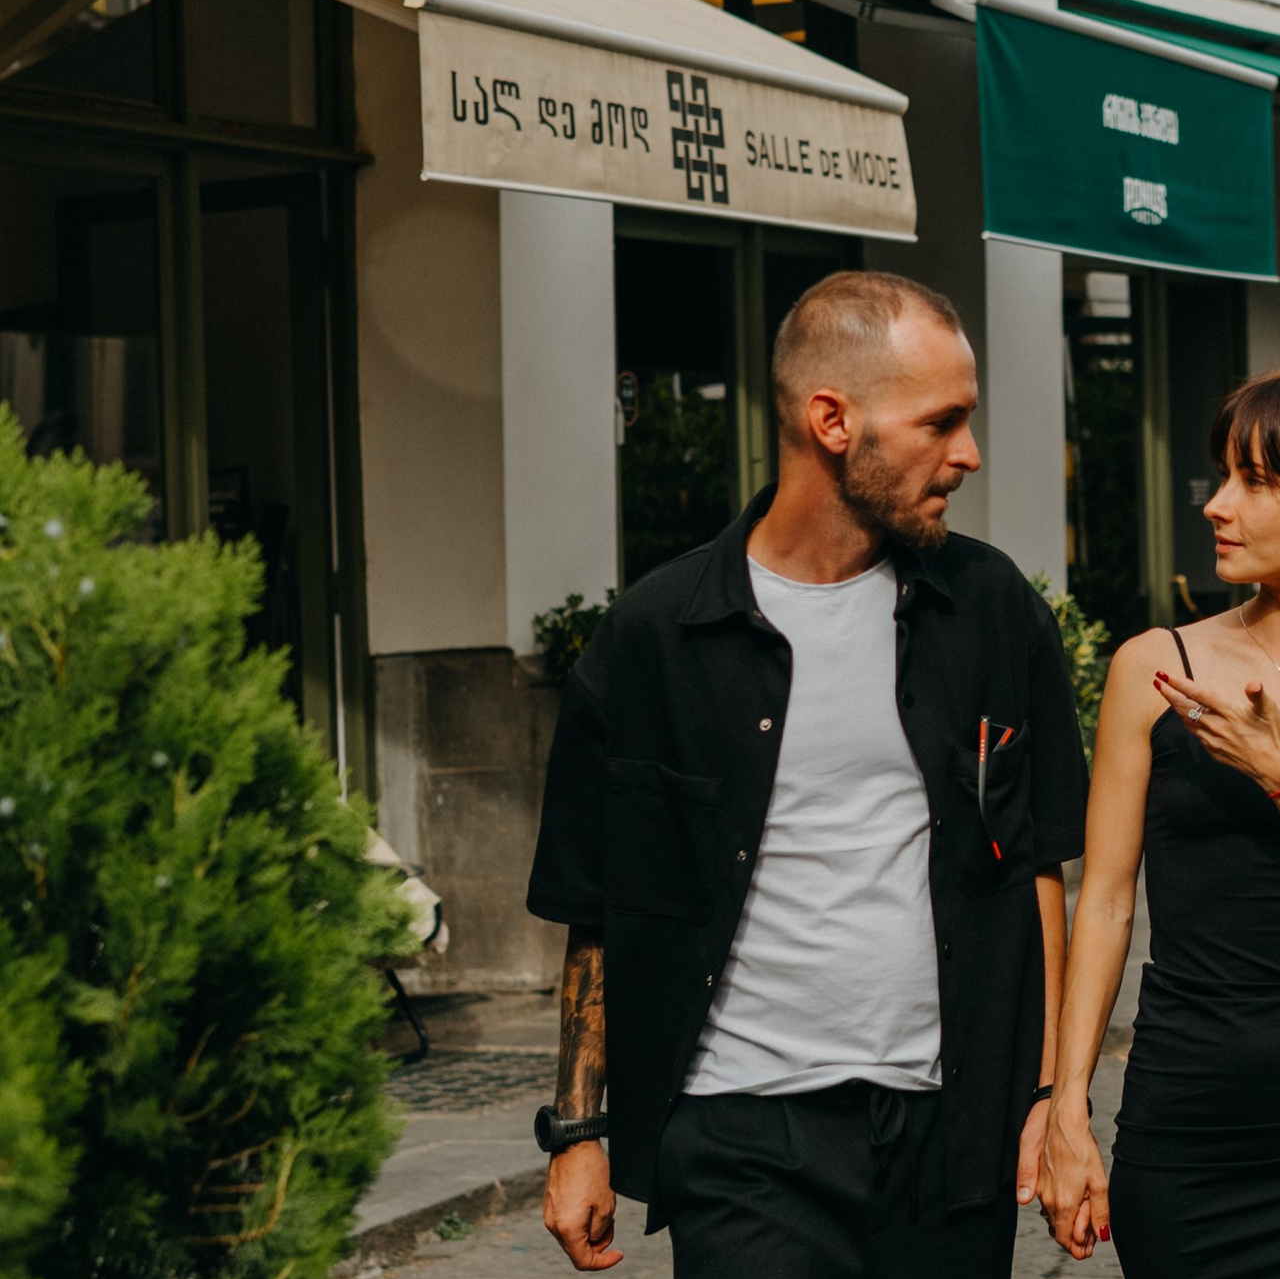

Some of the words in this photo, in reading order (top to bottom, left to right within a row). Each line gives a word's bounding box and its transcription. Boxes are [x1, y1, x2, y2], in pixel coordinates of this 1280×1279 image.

[451, 71, 522, 132] სალ
[538, 97, 577, 140] დე
[590, 99, 651, 153] მოდ
[745, 129, 813, 175] SALLE
[820, 149, 843, 180] DE
[847, 148, 901, 190] MODE
